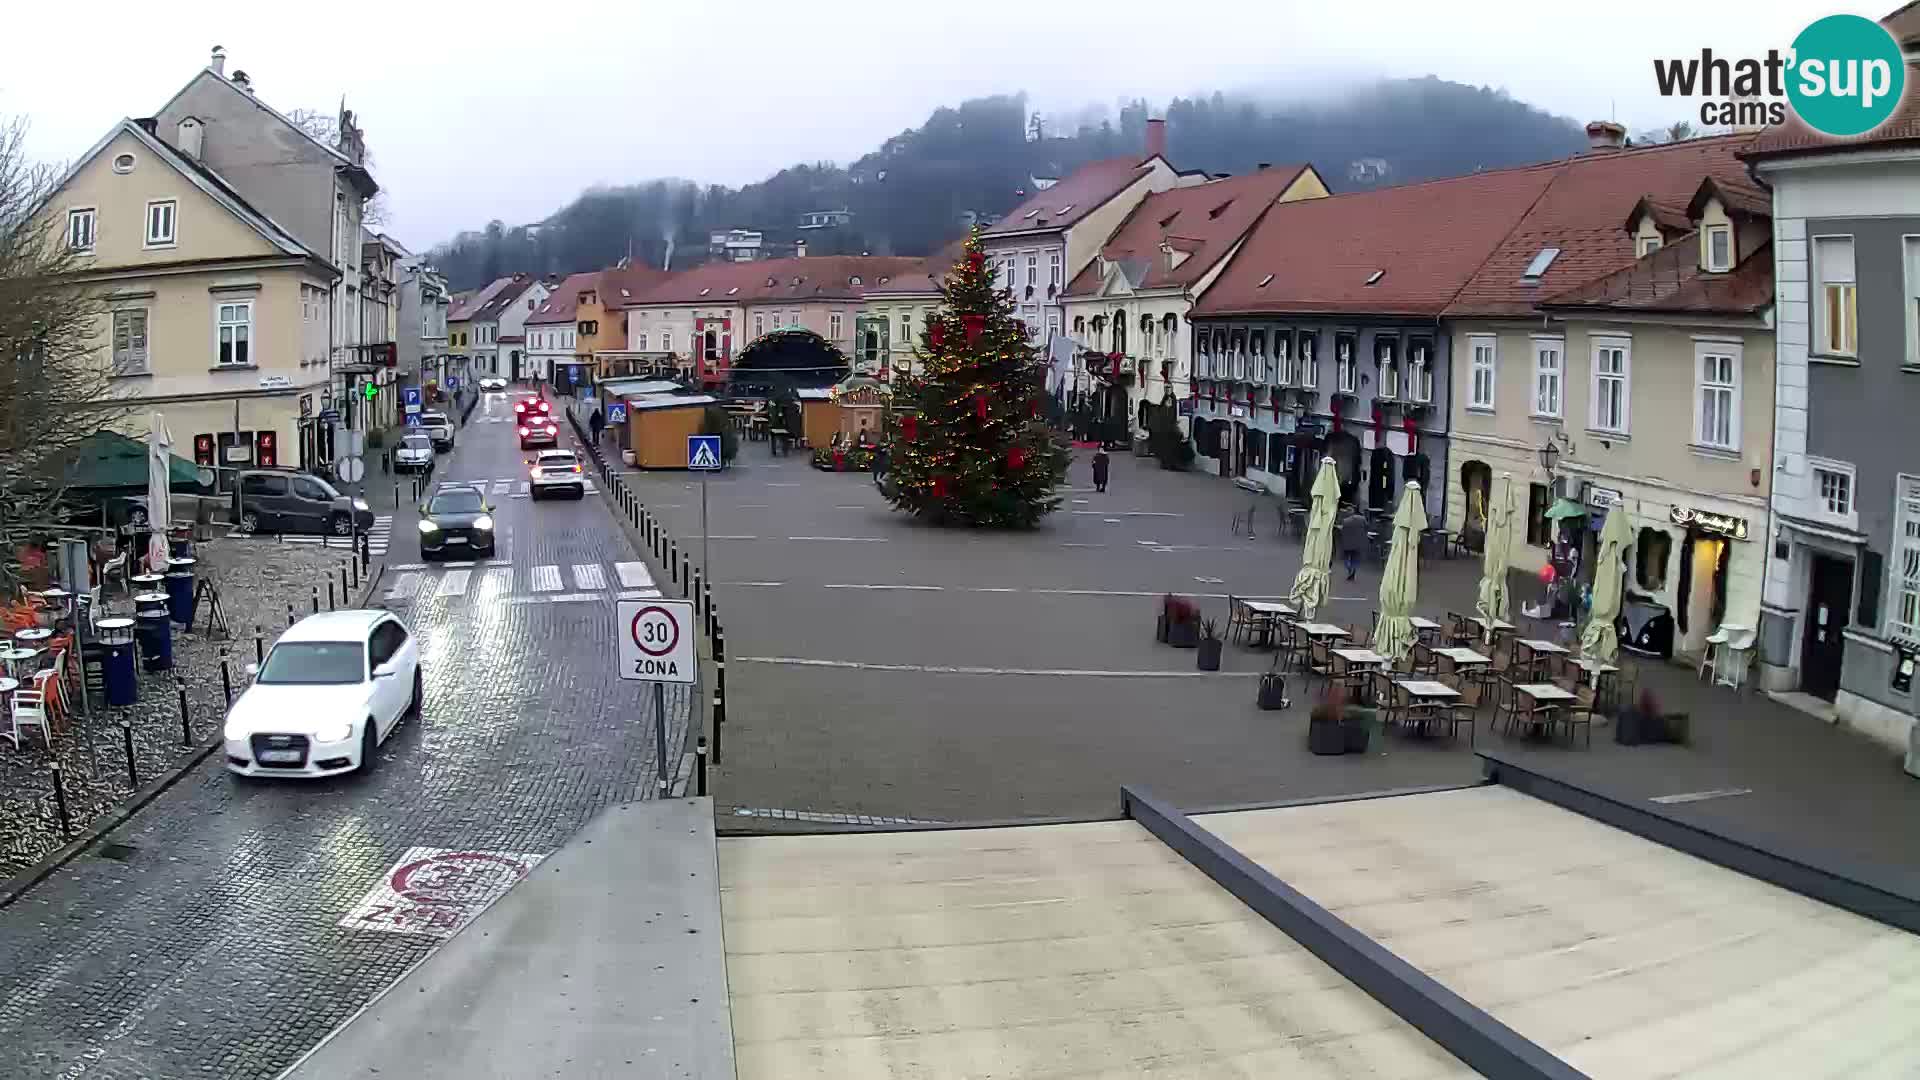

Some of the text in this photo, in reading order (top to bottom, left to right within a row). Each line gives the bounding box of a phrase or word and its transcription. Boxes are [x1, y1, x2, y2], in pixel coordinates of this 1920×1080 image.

[408, 391, 417, 402] P
[643, 622, 668, 643] 30
[634, 660, 678, 676] ZONA
